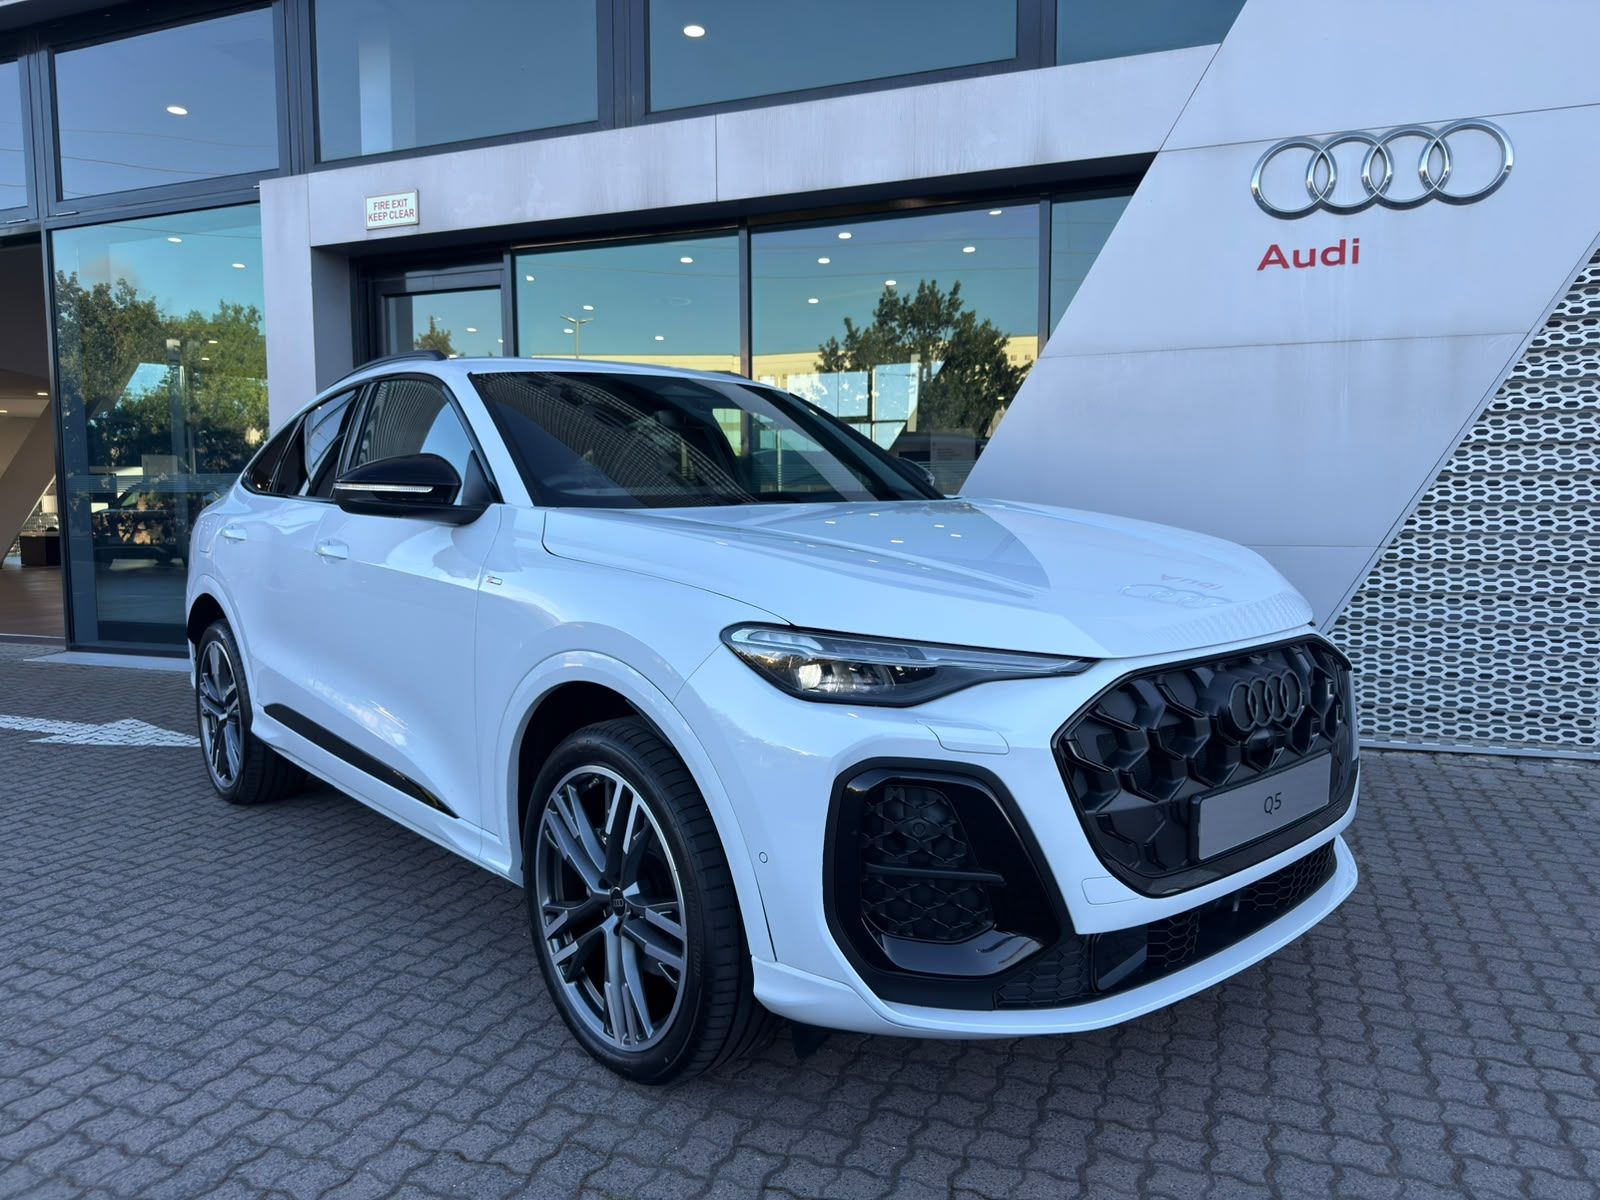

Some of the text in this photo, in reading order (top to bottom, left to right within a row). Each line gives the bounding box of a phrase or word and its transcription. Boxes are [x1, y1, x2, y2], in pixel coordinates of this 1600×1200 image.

[373, 198, 408, 211] FIRE EXIT
[368, 208, 414, 222] KEEP CLEAR
[1257, 238, 1360, 271] Audi
[1263, 792, 1282, 815] Q5
